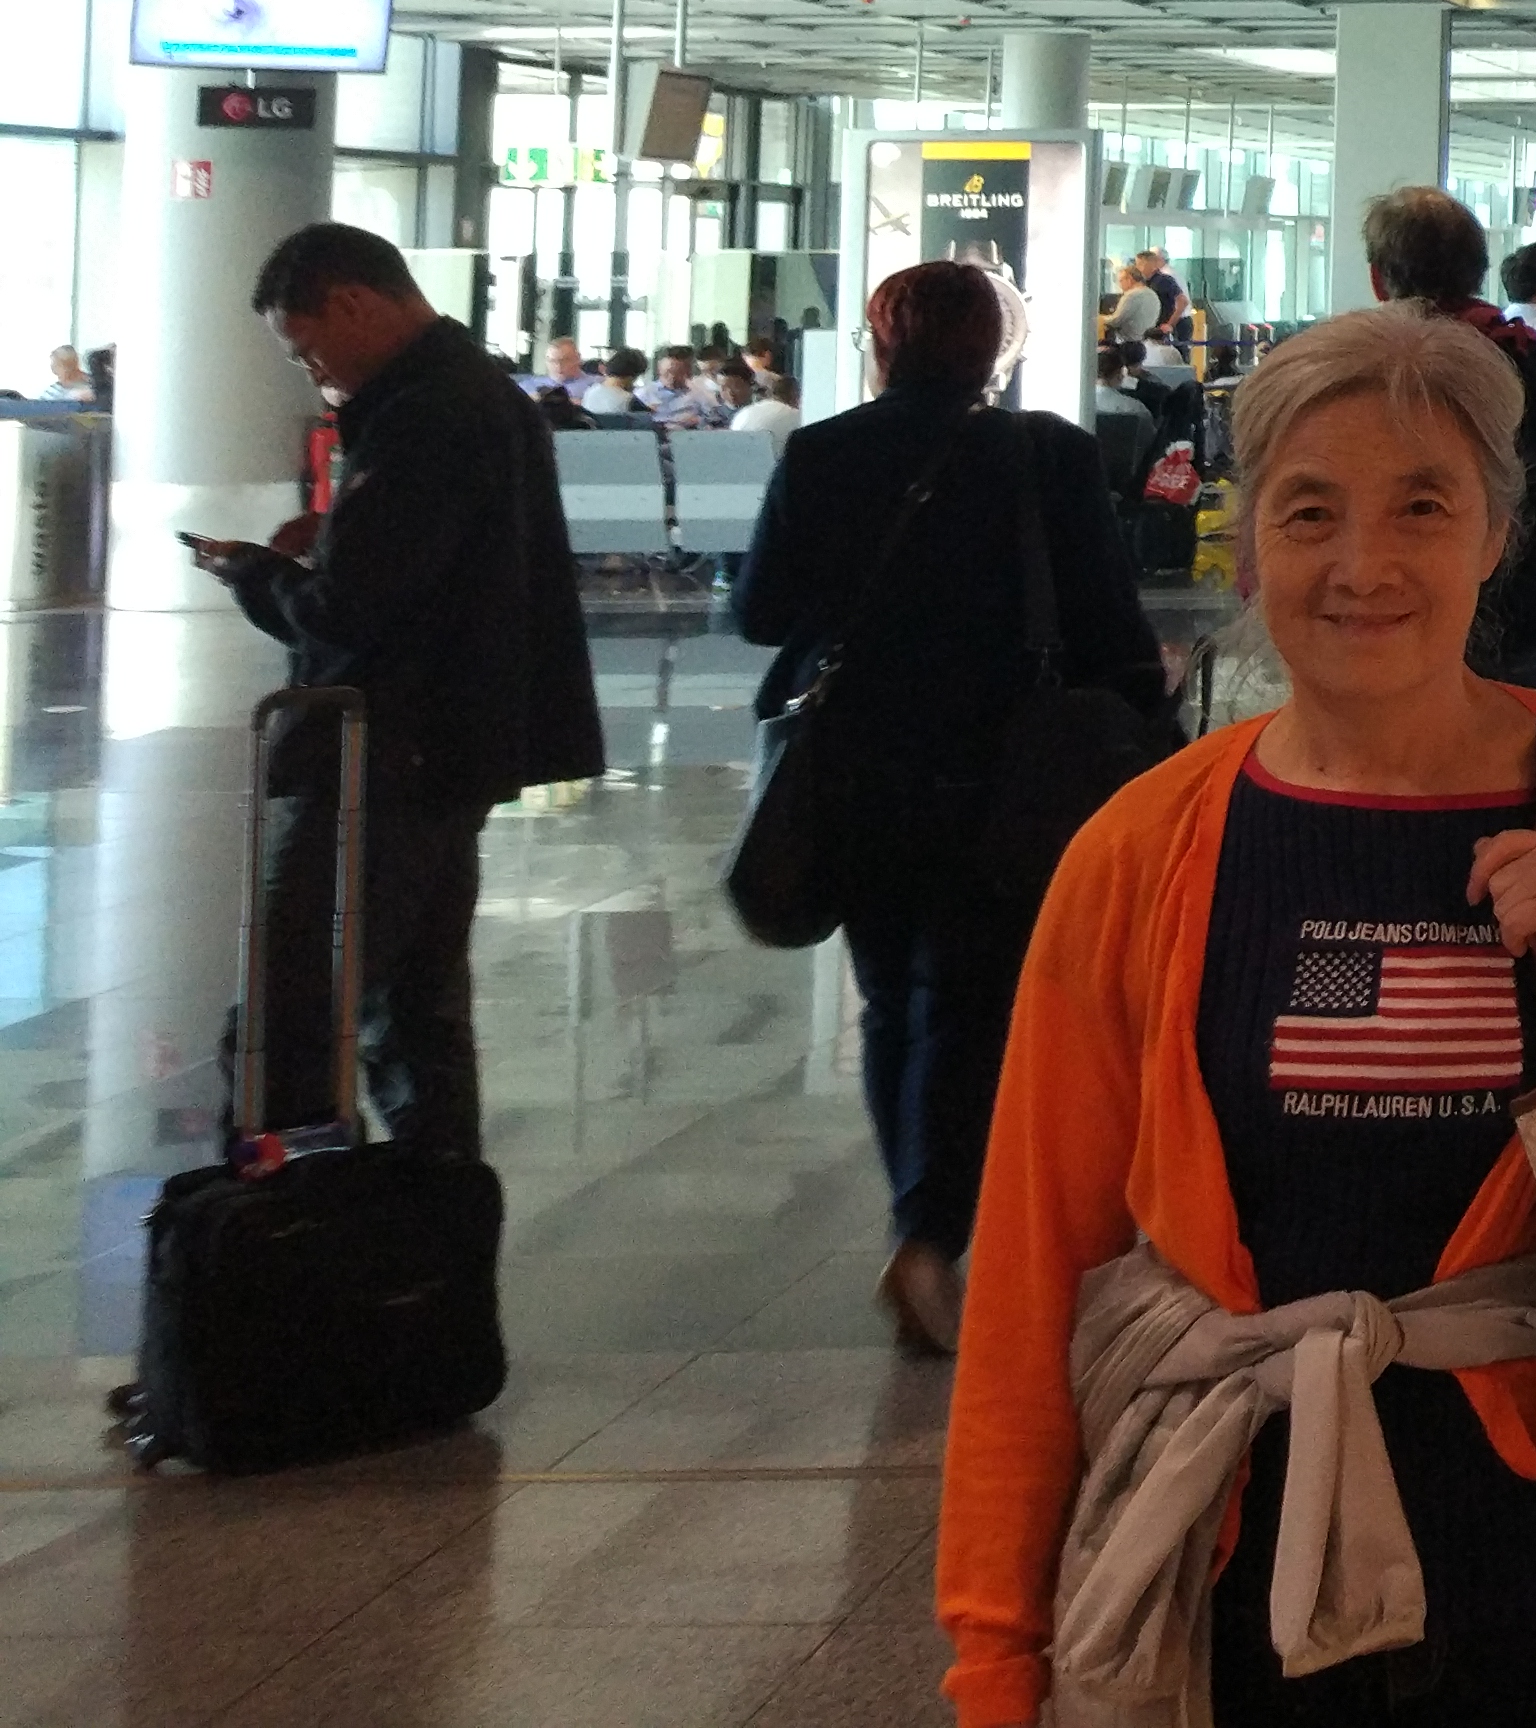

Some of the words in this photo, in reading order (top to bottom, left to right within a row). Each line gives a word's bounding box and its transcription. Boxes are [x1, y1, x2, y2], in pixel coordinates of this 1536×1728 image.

[256, 96, 294, 120] LG
[925, 192, 1025, 208] BREITLING
[1300, 919, 1347, 941] POLO
[1349, 921, 1413, 944] JEANS
[1283, 1090, 1349, 1118] RALPH
[1351, 1094, 1433, 1119] LAUREN
[1438, 1090, 1501, 1119] U.S.A.
